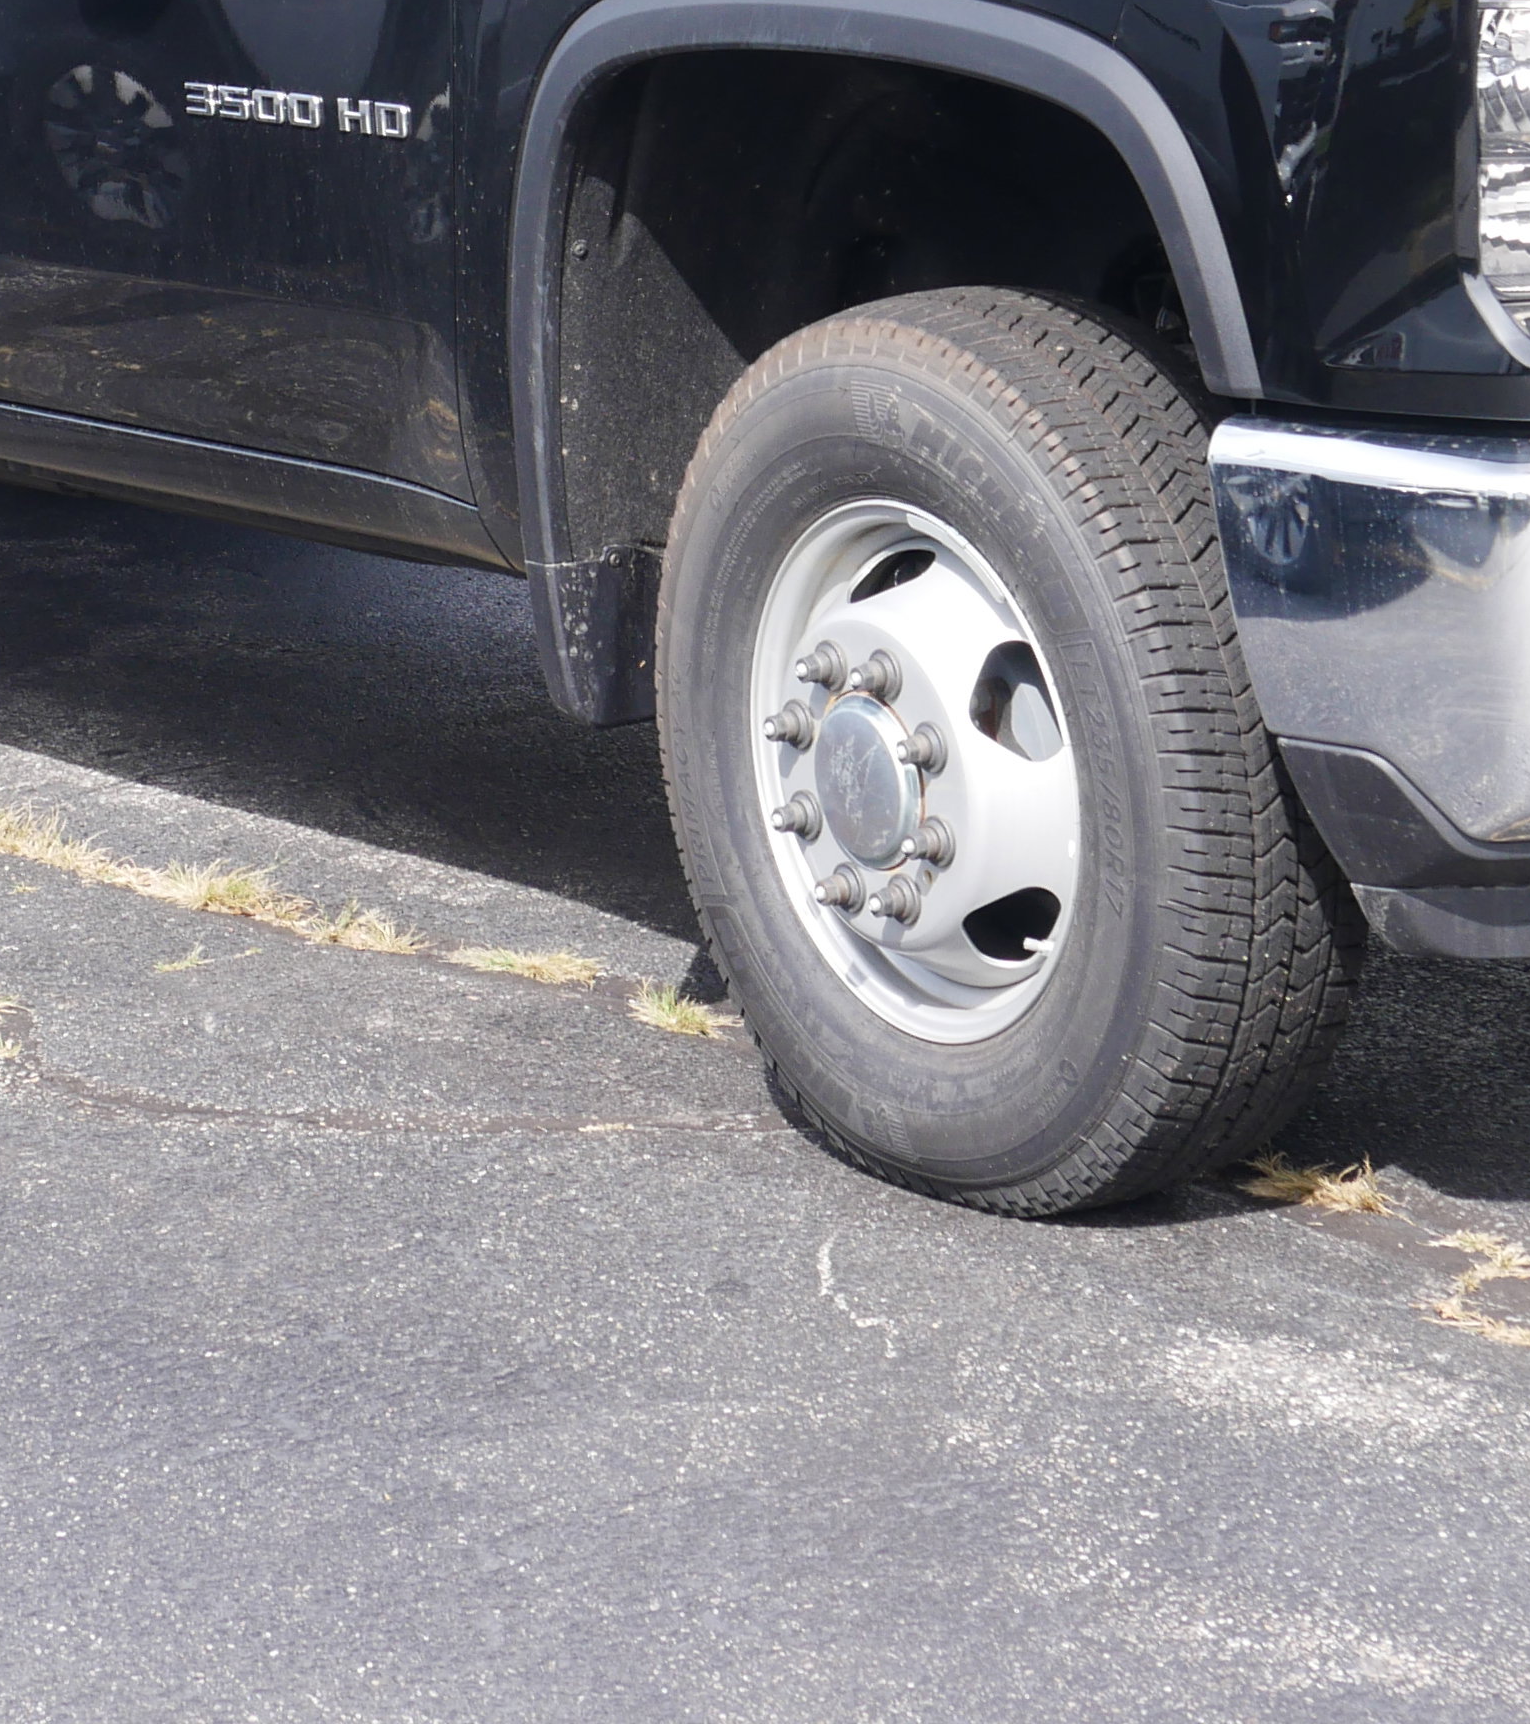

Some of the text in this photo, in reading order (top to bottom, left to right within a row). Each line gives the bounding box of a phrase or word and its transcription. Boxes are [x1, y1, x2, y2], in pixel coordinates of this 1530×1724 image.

[183, 80, 412, 139] 3500 HD
[672, 722, 717, 885] PRIMACY
